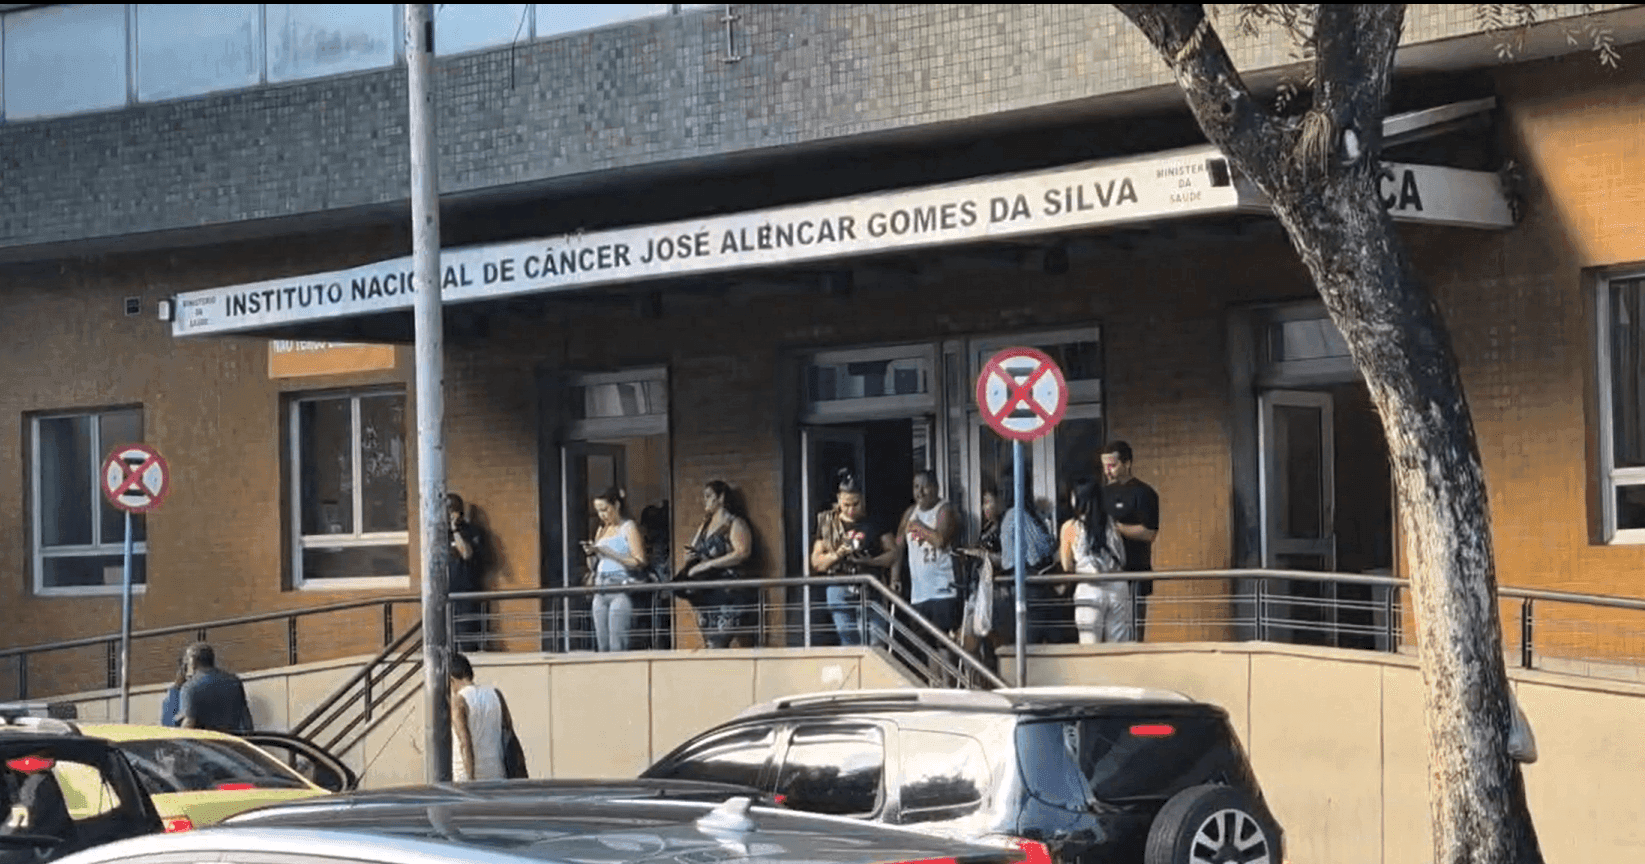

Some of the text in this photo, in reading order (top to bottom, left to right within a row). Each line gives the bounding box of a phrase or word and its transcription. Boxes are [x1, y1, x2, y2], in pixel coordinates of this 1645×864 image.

[1156, 164, 1204, 178] MINISTER
[1178, 178, 1191, 188] DA
[1377, 169, 1423, 211] CA
[225, 177, 1138, 316] INSTITUTO NACIAL DE CÂNCER JOSÉ ALENCAR GOMES DA SILVA
